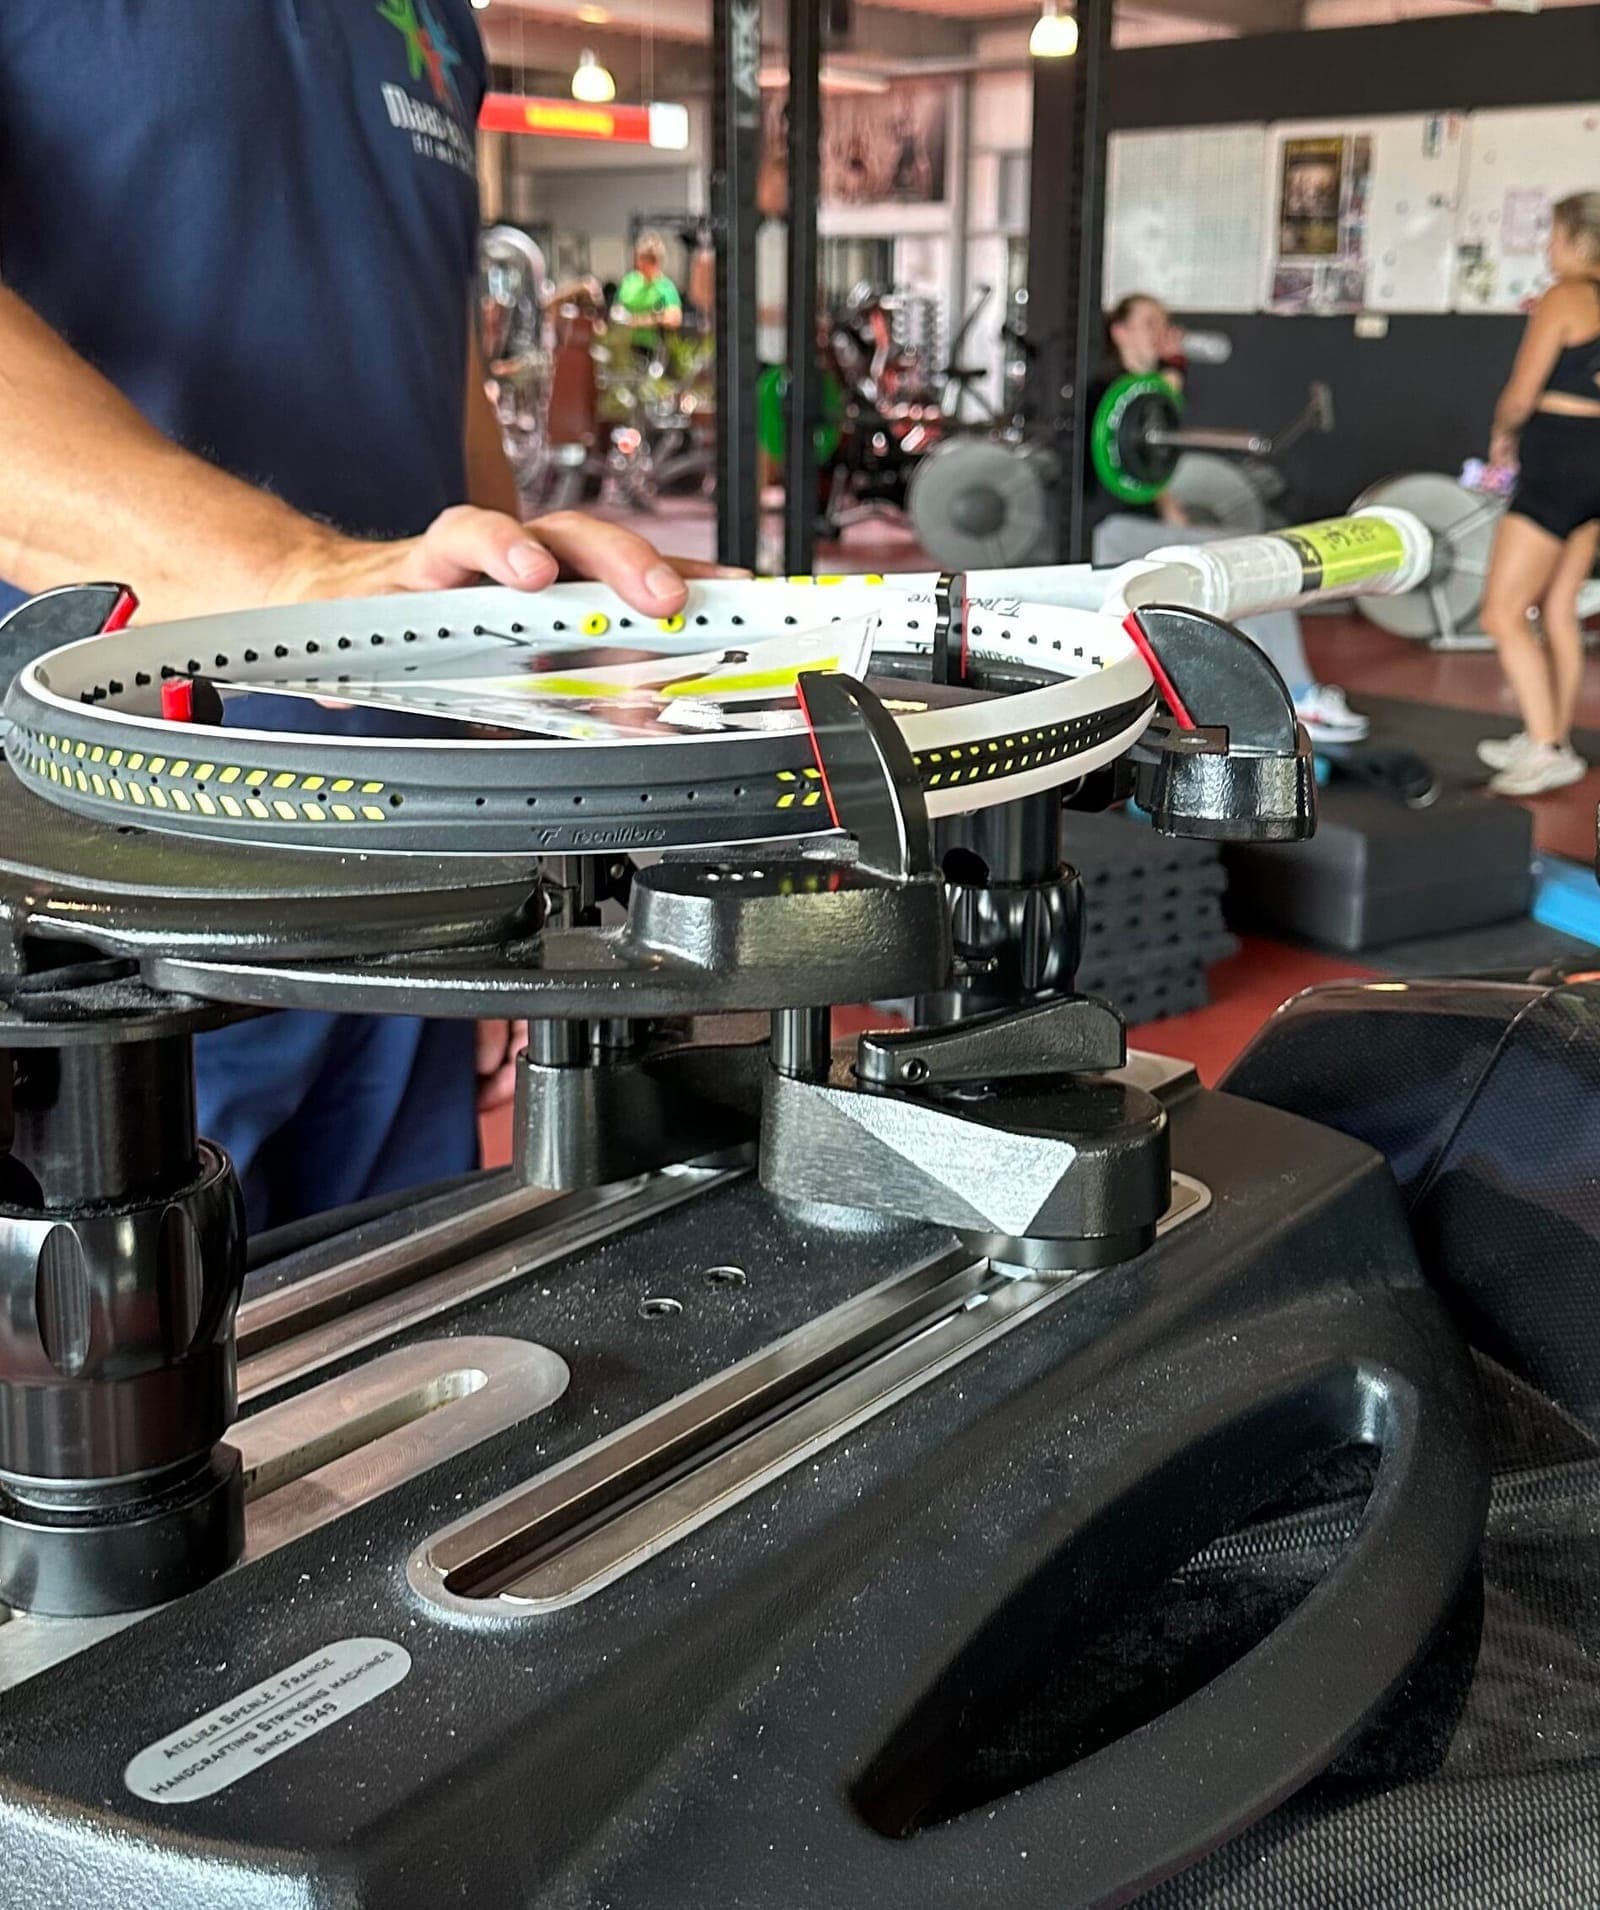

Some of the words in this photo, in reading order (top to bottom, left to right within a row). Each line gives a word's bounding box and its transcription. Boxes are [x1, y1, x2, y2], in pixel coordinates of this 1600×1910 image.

[150, 1731, 258, 1795] HANDCRAFTING
[256, 1688, 330, 1732] STRINGING
[329, 1650, 394, 1690] MACHINES
[163, 1725, 220, 1759] ATELIER
[281, 1657, 335, 1690] FRANCE
[253, 1728, 296, 1755] SINCE
[295, 1703, 337, 1730] 1949
